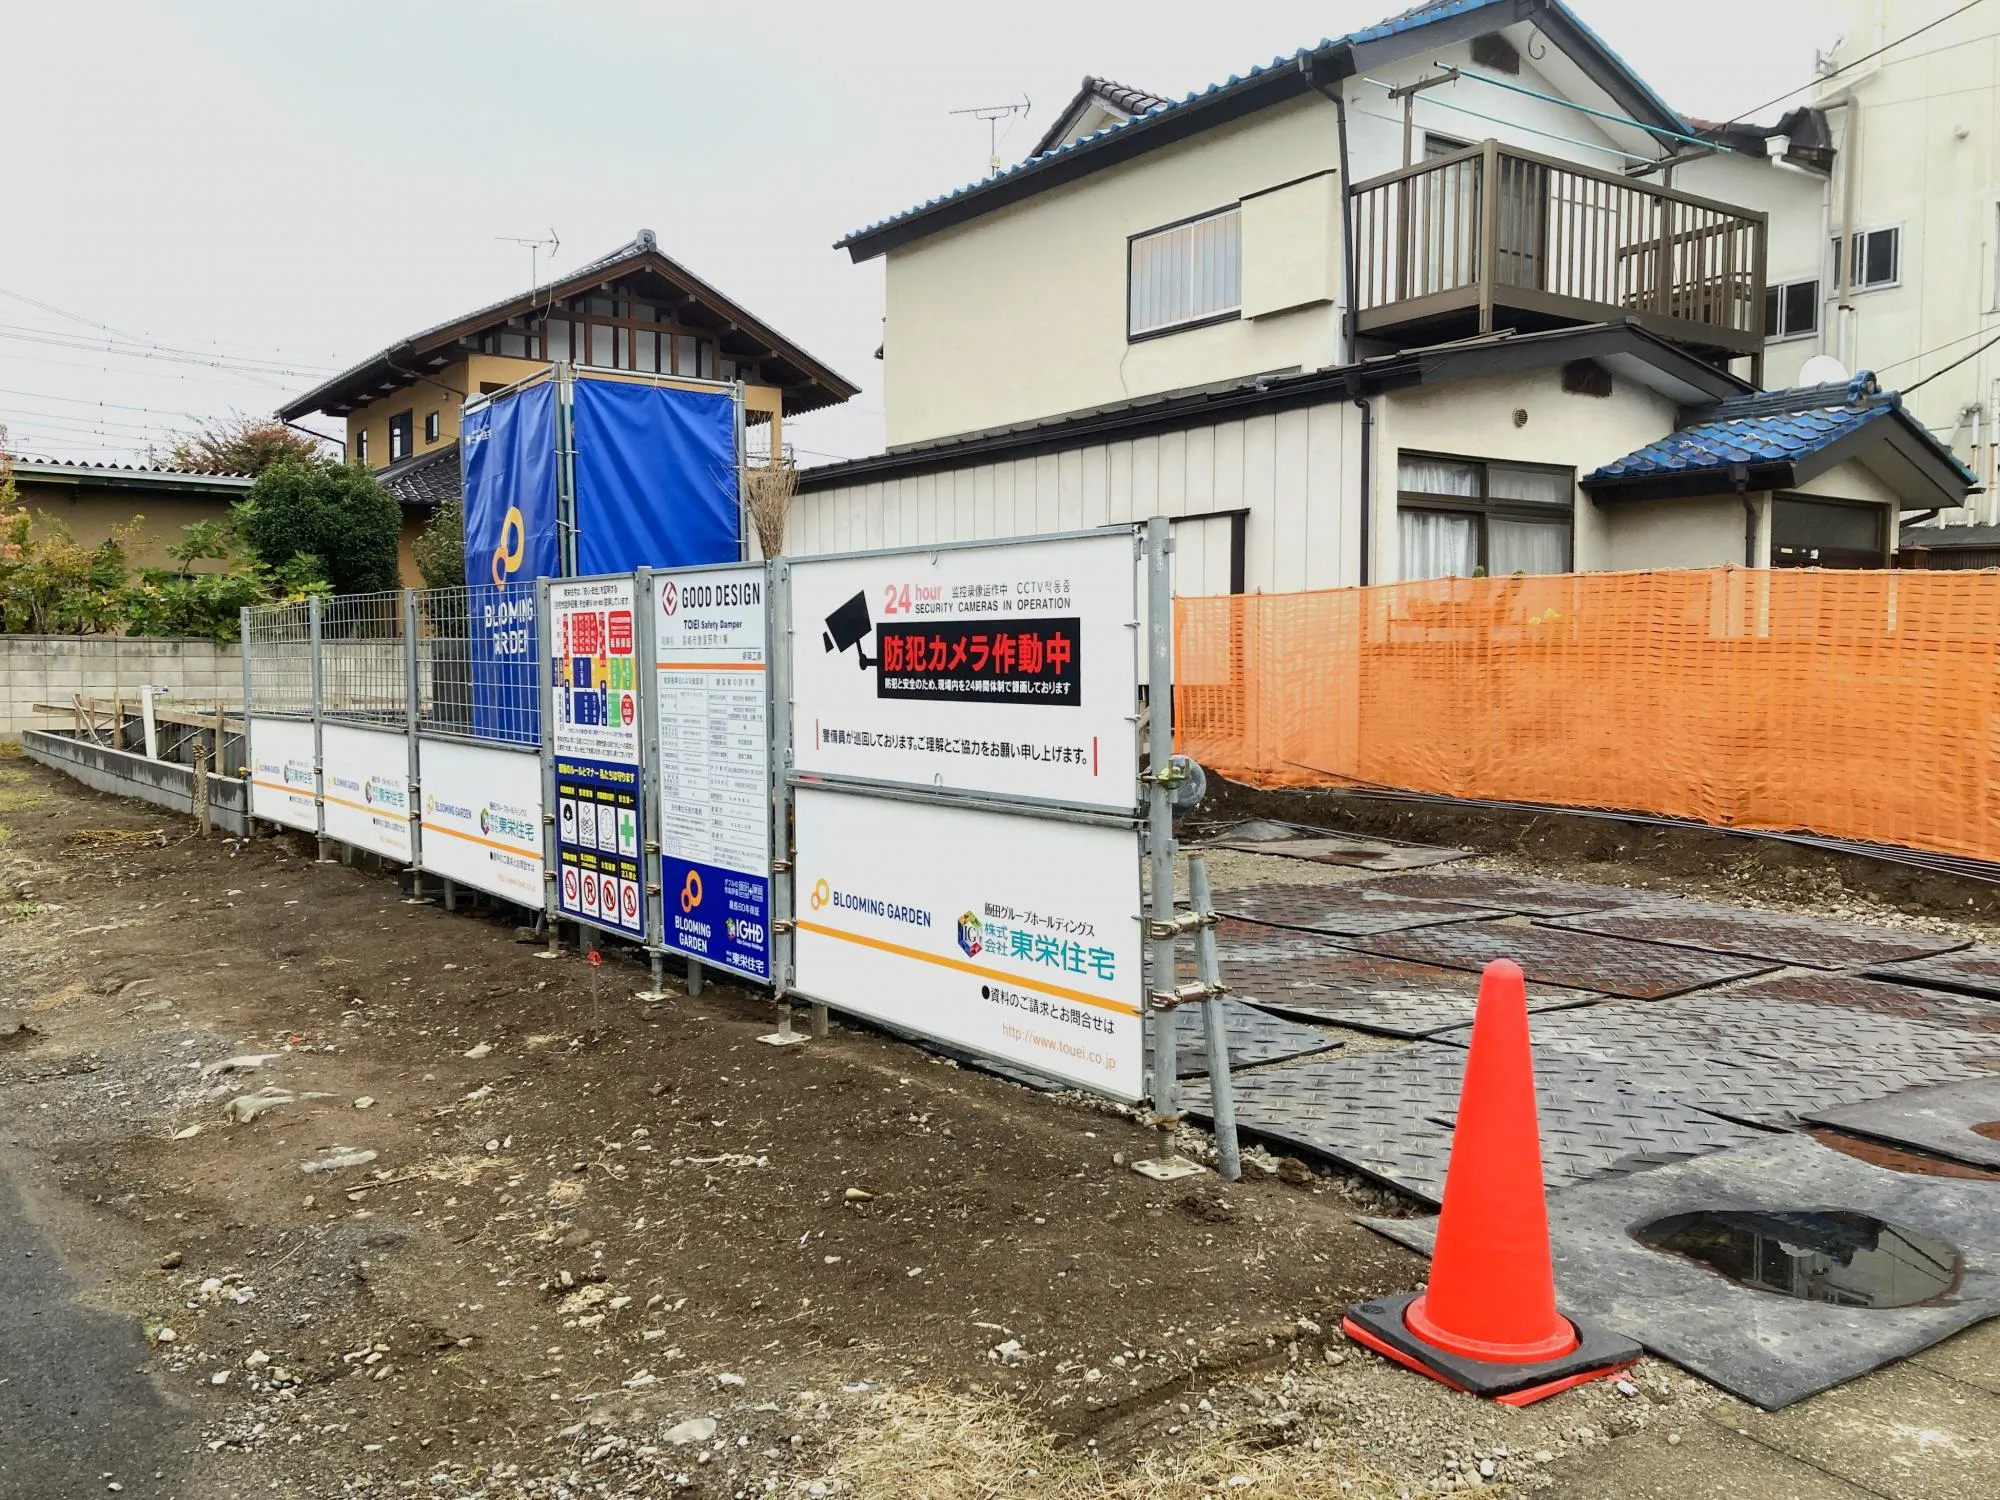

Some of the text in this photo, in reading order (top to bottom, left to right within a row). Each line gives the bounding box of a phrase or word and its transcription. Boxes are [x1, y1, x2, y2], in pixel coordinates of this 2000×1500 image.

[682, 582, 760, 608] GOOD DESIGN
[884, 583, 943, 614] 24 hour
[951, 583, 1008, 599] 监控录像运作中
[915, 597, 1071, 614] SECURITY CAMERAS IN OPERATION
[701, 620, 718, 631] Safety
[720, 619, 743, 631] Damper
[884, 632, 1071, 675] 防犯カメラ作動中
[499, 816, 534, 842] 東栄住宅
[833, 891, 931, 928] BLOOMING GARDEN
[984, 902, 1096, 938] 飯田グループホールディングス
[675, 914, 711, 938] BLOOMING
[984, 921, 1008, 940] 株式
[679, 932, 708, 953] GARDEN
[984, 938, 1008, 957] 会社
[1010, 929, 1116, 981] 東栄住宅
[732, 951, 765, 974] 東栄住宅
[990, 985, 1116, 1036] 資料のご請求とお問合せは
[1002, 1023, 1117, 1071] http://www.touei.co.jp
